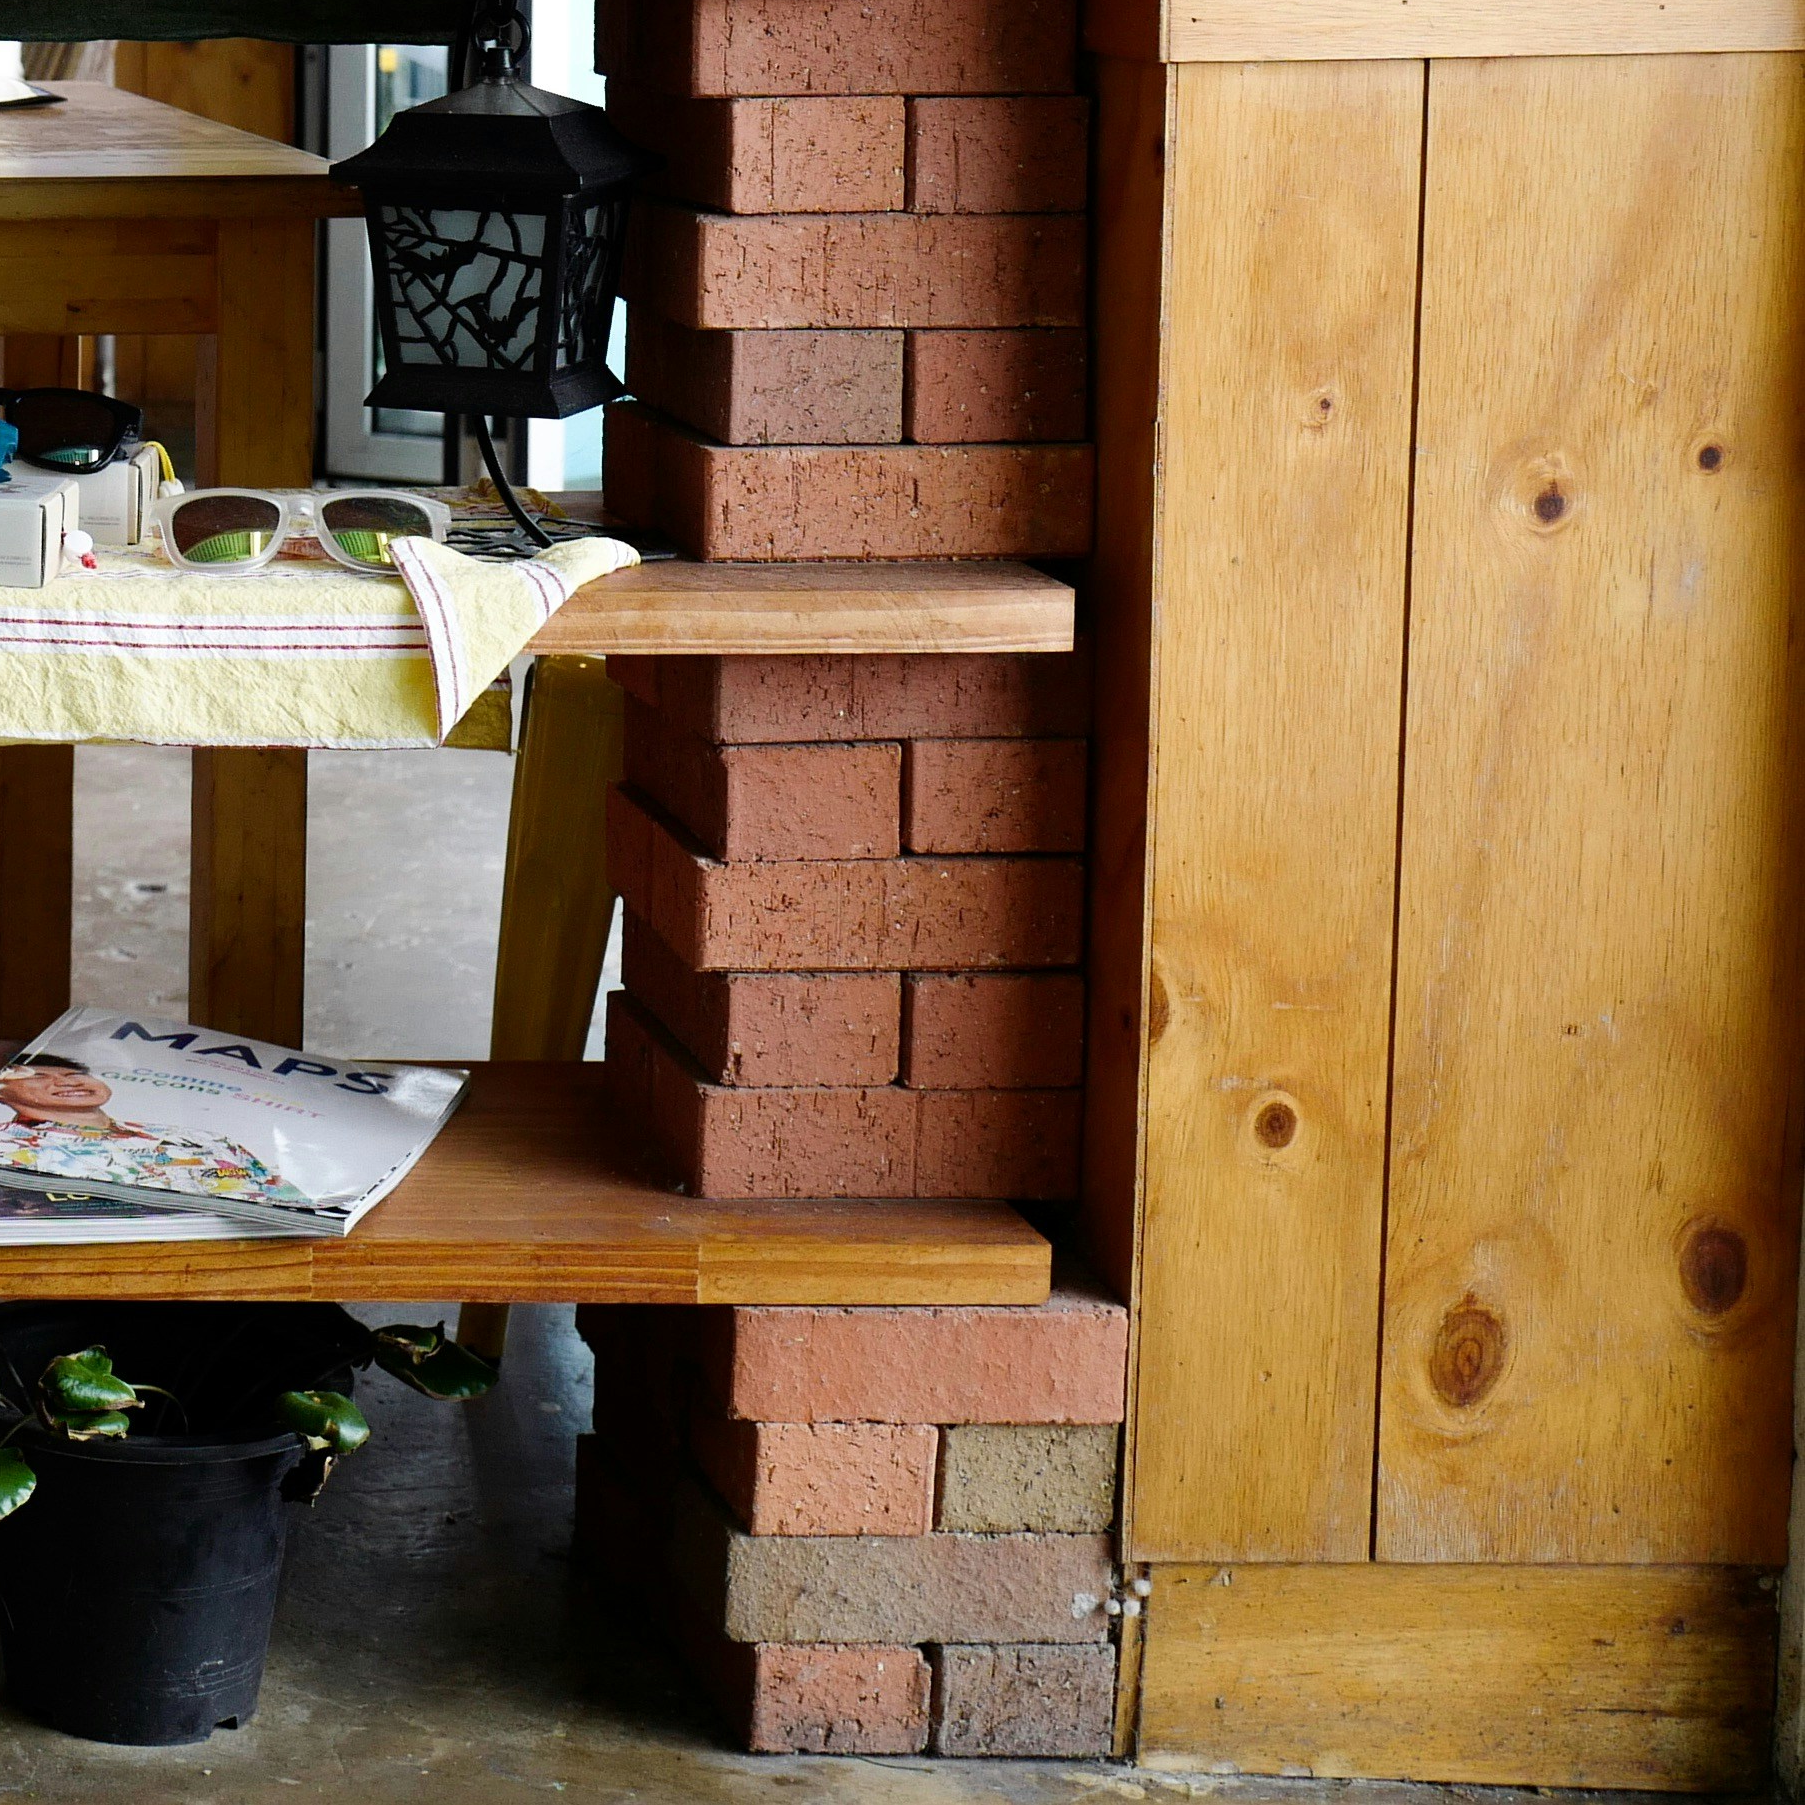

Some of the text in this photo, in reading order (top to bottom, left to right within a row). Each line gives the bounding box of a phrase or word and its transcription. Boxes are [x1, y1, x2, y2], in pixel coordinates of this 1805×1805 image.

[110, 1021, 392, 1095] MAPS
[133, 1068, 242, 1092] Comme
[101, 1070, 221, 1096] Garçons
[231, 1093, 325, 1118] SHIRT
